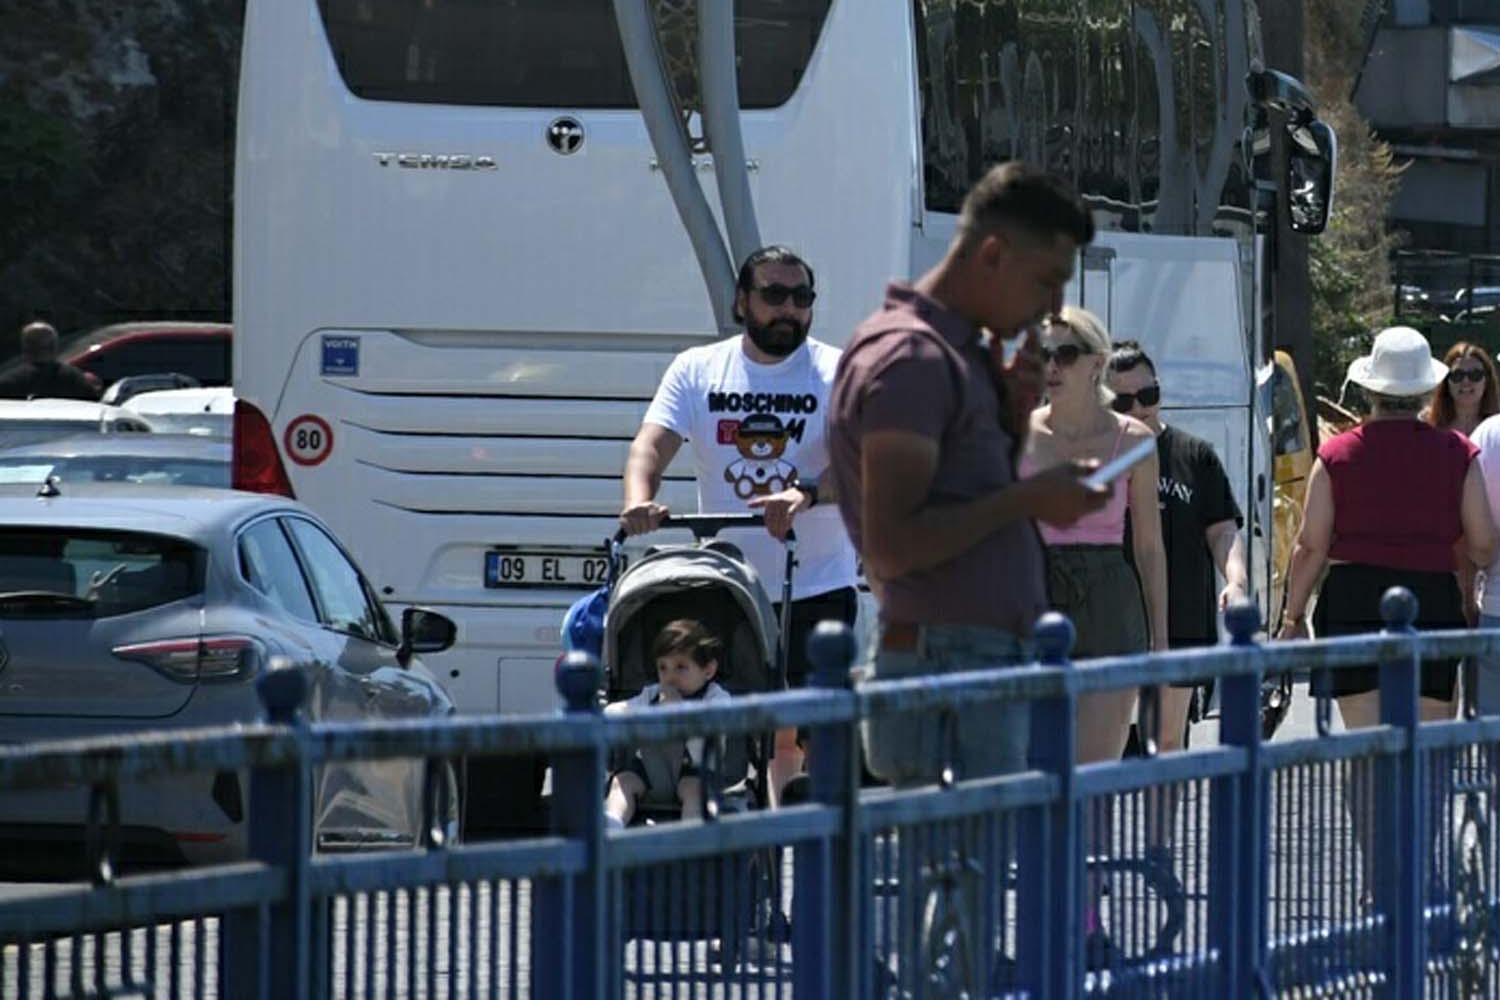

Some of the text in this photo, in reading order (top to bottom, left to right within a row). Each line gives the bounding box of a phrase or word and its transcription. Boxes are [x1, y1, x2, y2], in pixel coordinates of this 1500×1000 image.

[372, 152, 498, 170] TEMSA
[708, 391, 818, 414] MOSCHINO
[296, 429, 321, 450] 80
[500, 557, 525, 580] 09
[542, 558, 566, 581] EL
